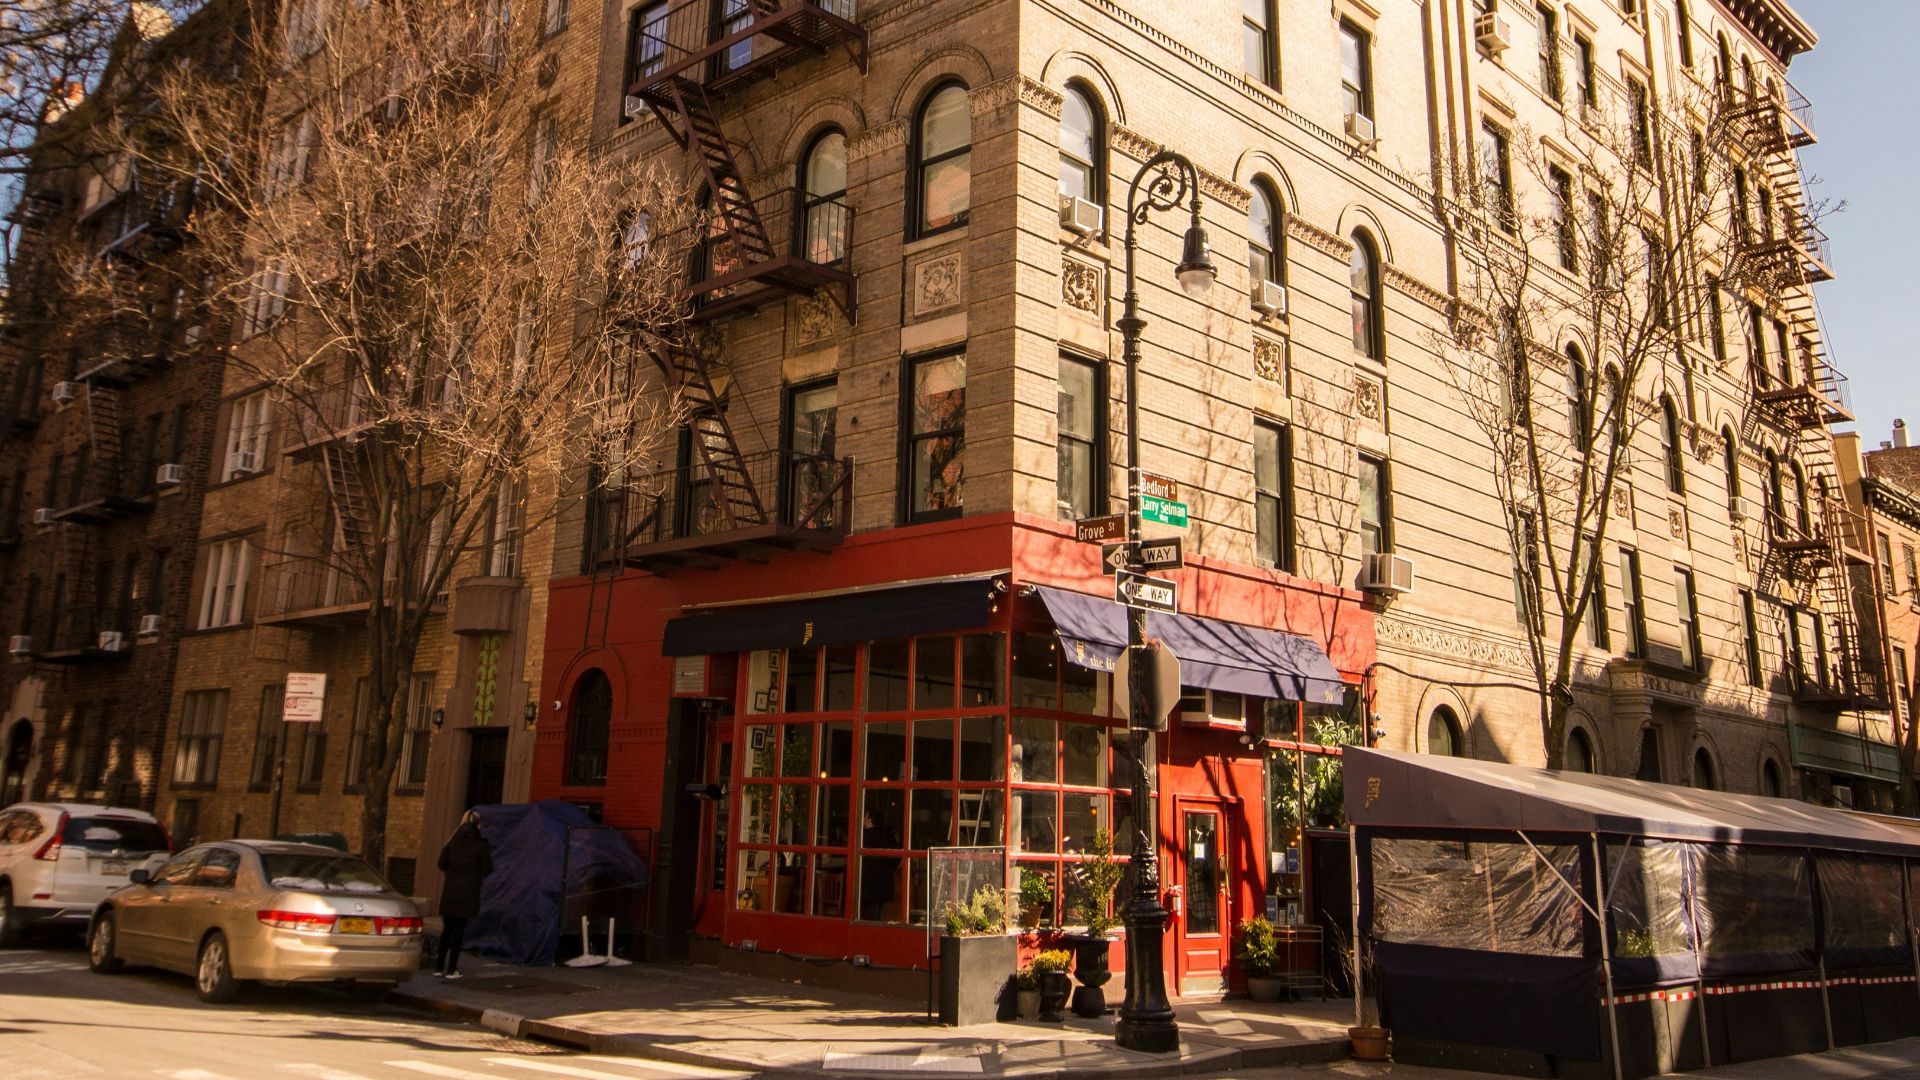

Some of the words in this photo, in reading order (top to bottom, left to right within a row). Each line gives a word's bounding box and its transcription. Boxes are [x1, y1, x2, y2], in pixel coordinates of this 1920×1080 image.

[1141, 477, 1169, 498] Bedford
[1170, 484, 1176, 495] St
[1142, 497, 1159, 516] Larry
[1160, 501, 1186, 518] Selman
[1159, 514, 1169, 523] Way
[1078, 525, 1105, 541] Grove
[1108, 521, 1115, 532] St
[1114, 551, 1129, 565] ON
[1146, 548, 1171, 562] WAY
[1125, 582, 1143, 597] ONE
[1150, 587, 1169, 602] WAY
[1090, 654, 1104, 669] the
